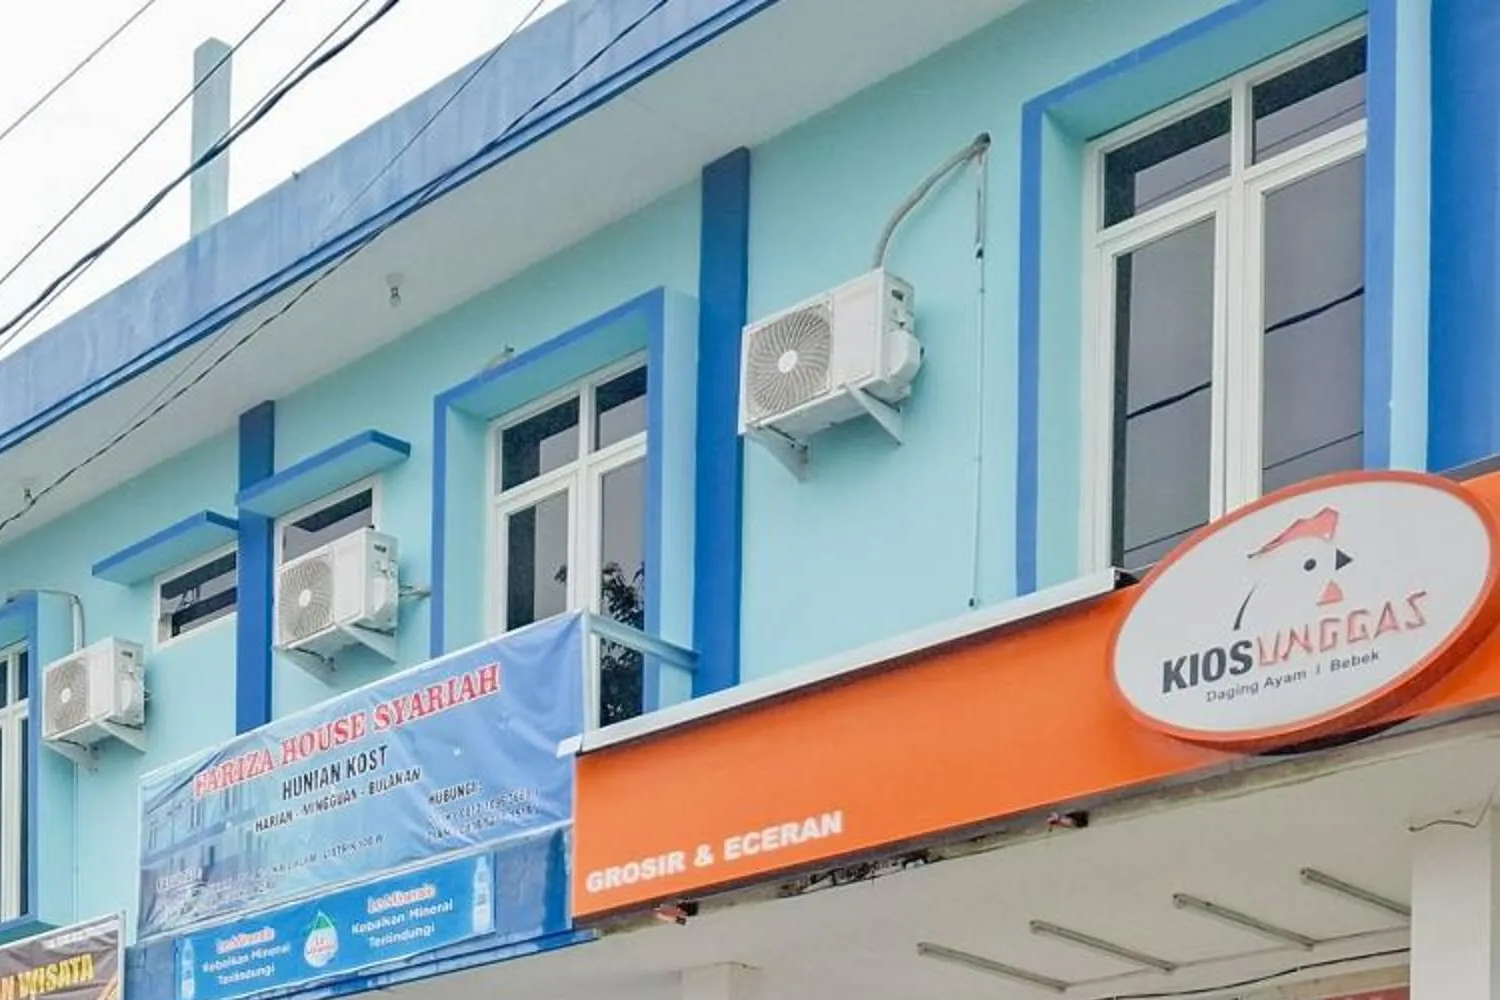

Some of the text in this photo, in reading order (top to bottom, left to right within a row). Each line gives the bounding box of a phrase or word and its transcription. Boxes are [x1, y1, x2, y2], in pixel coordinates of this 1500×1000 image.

[1162, 591, 1428, 694] KIOS UNGGAS
[1206, 678, 1260, 703] Daging
[1263, 669, 1308, 691] Ayam
[1330, 650, 1380, 673] Bebek
[280, 711, 366, 767] HOUSE
[373, 662, 501, 733] SYARIAH
[281, 745, 389, 801] HUNIAN KOST
[585, 810, 844, 893] GROSIR & ECERAN
[408, 898, 454, 923] Mineral
[18, 952, 95, 998] WISATA
